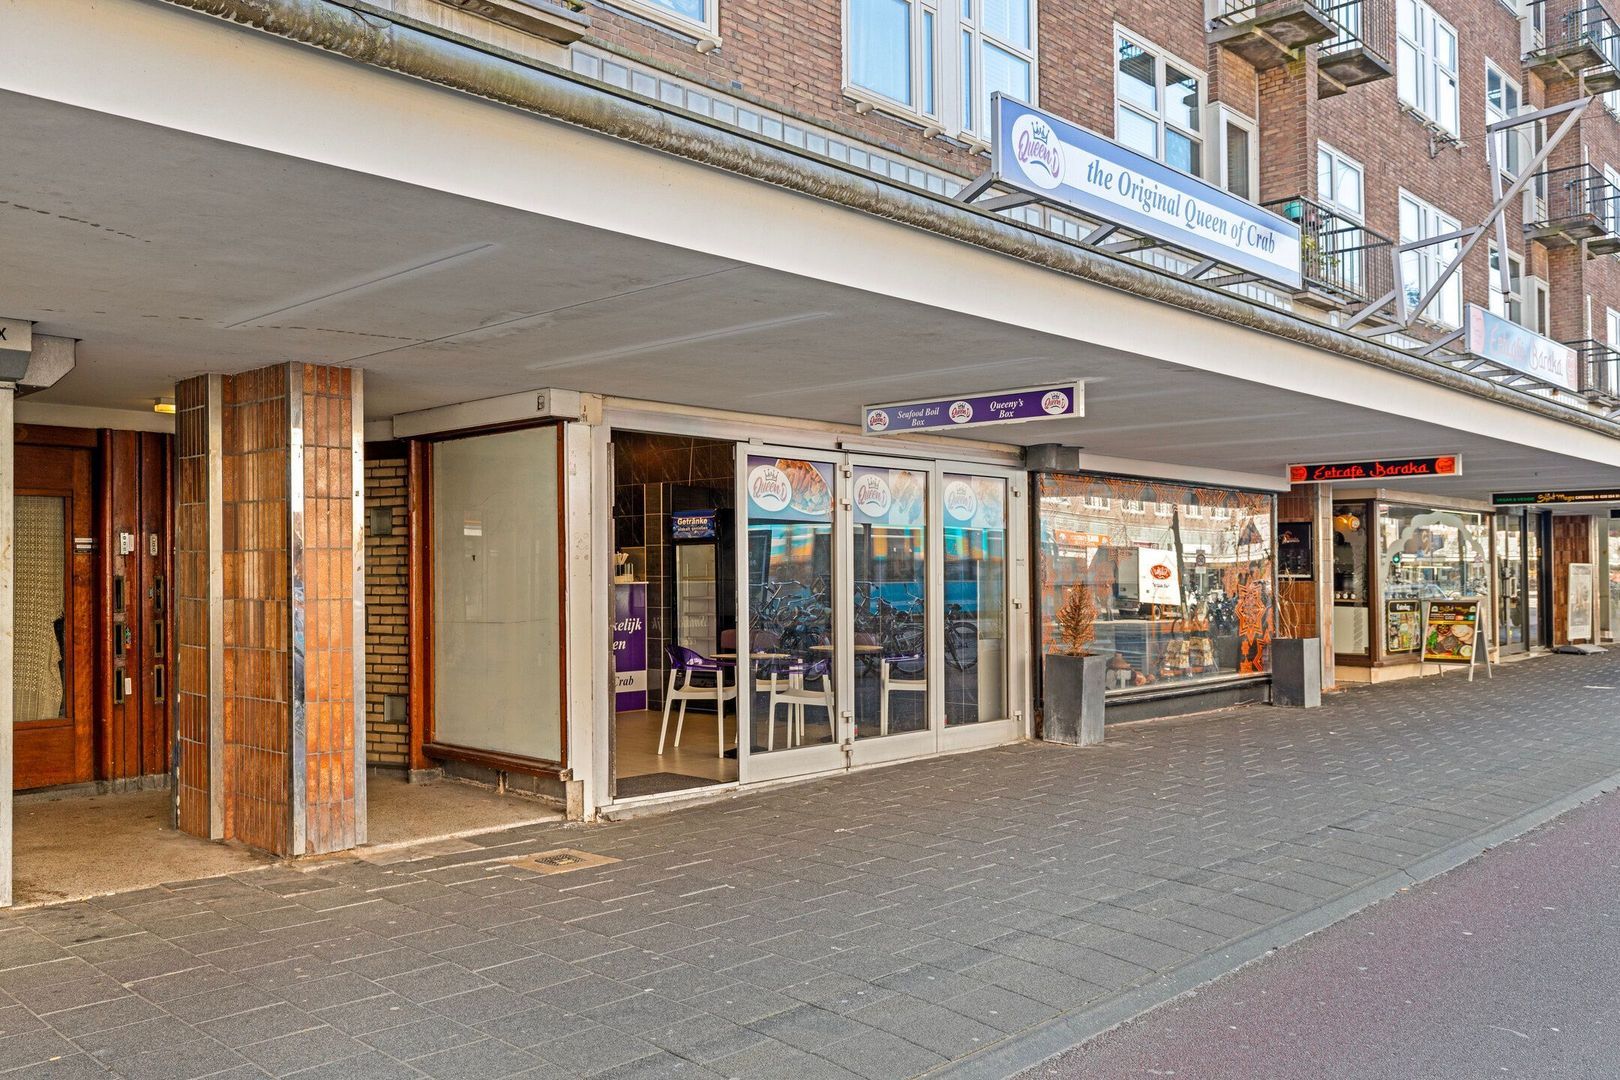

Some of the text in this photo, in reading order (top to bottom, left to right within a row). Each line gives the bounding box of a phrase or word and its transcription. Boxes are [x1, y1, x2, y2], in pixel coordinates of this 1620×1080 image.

[1087, 160, 1275, 254] the Original Queen of Crab
[990, 398, 1024, 412] Queeny's
[897, 406, 940, 420] Seafood Boil
[999, 410, 1015, 419] Box
[911, 418, 925, 427] Box
[1369, 460, 1430, 478] Baraka
[677, 517, 708, 525] Getränke
